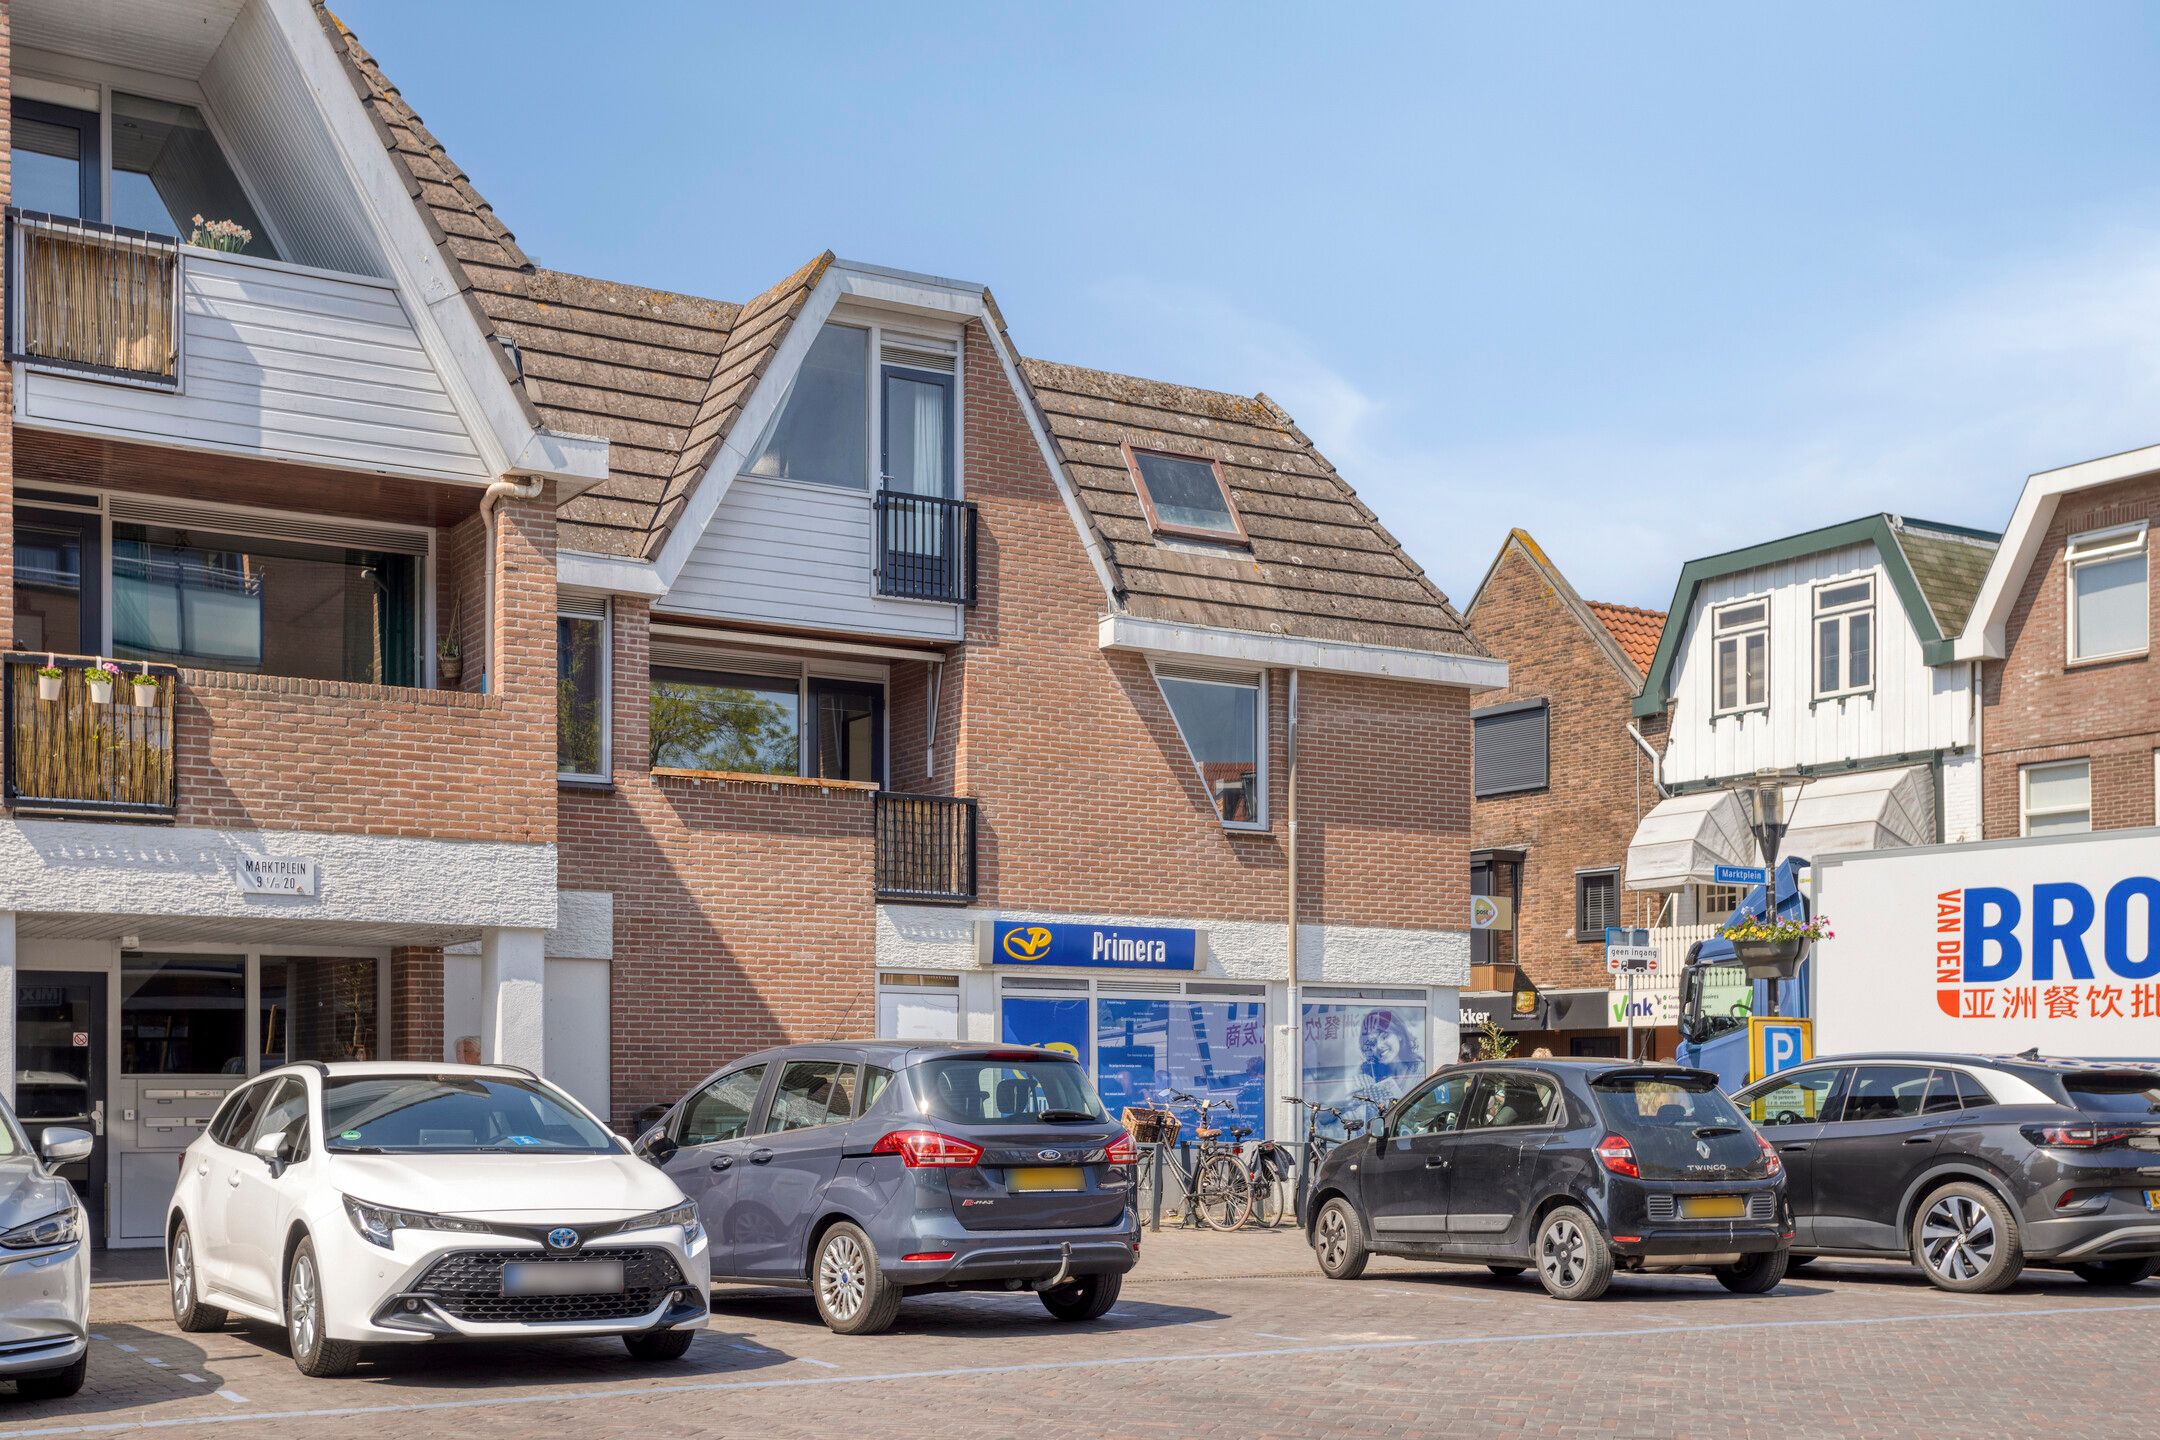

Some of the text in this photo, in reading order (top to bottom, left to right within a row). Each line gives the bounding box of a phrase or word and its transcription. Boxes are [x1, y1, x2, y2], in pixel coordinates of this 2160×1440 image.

[245, 860, 306, 875] MARKTPLEIN
[1721, 869, 1762, 881] Marktplein
[256, 876, 263, 888] 9
[283, 877, 296, 889] 20
[1936, 888, 1961, 983] VAN DEN
[1963, 876, 2160, 983] BRO
[1092, 931, 1167, 963] Primera
[1631, 949, 1657, 958] ingang
[1962, 983, 2160, 1019] 亚洲餐饮批
[1459, 1008, 1491, 1024] kker
[1772, 1033, 1794, 1073] P
